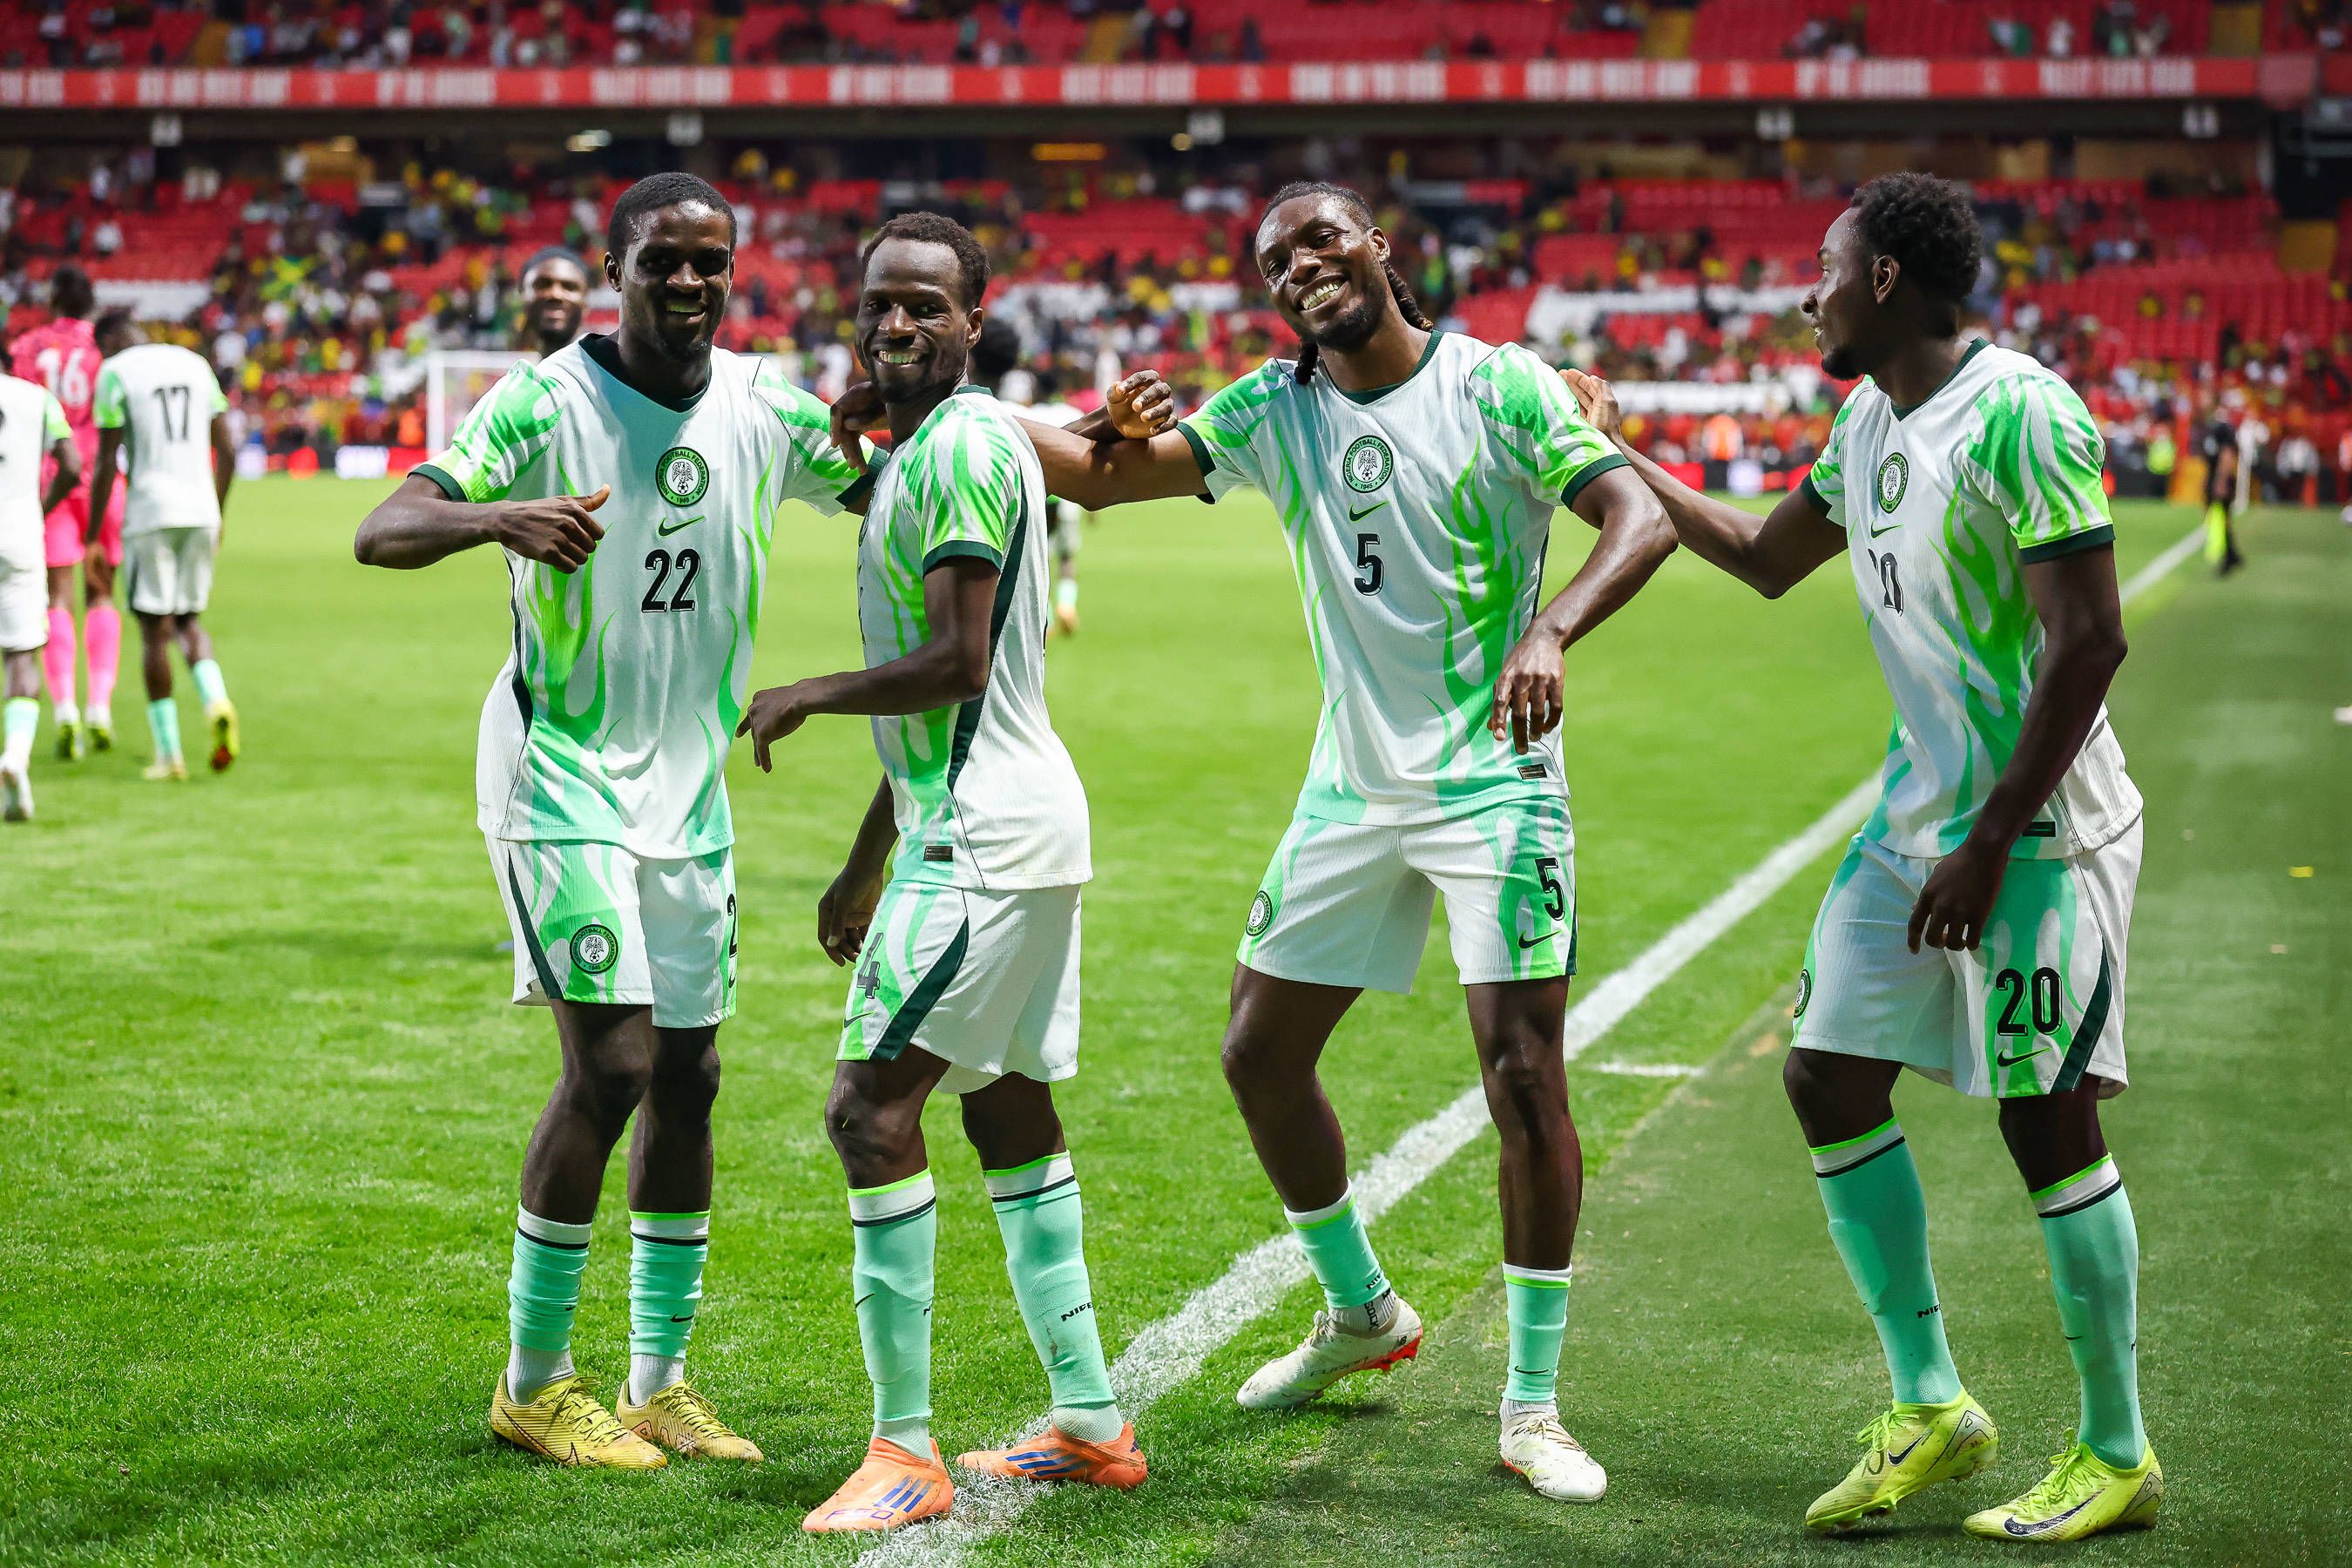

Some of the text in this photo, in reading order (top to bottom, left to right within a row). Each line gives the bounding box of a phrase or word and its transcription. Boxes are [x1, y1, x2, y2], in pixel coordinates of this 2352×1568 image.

[35, 348, 88, 408] 16
[154, 385, 190, 442] 17
[658, 449, 706, 496] NIGERIA FOOTBALL FEDERATION
[1345, 438, 1390, 483] NIGERIA FOOTBALL FEDERATION
[641, 548, 701, 613] 22
[1354, 533, 1384, 596] 5
[1534, 857, 1565, 921] 5
[856, 932, 884, 999] 4
[1996, 967, 2063, 1037] 20
